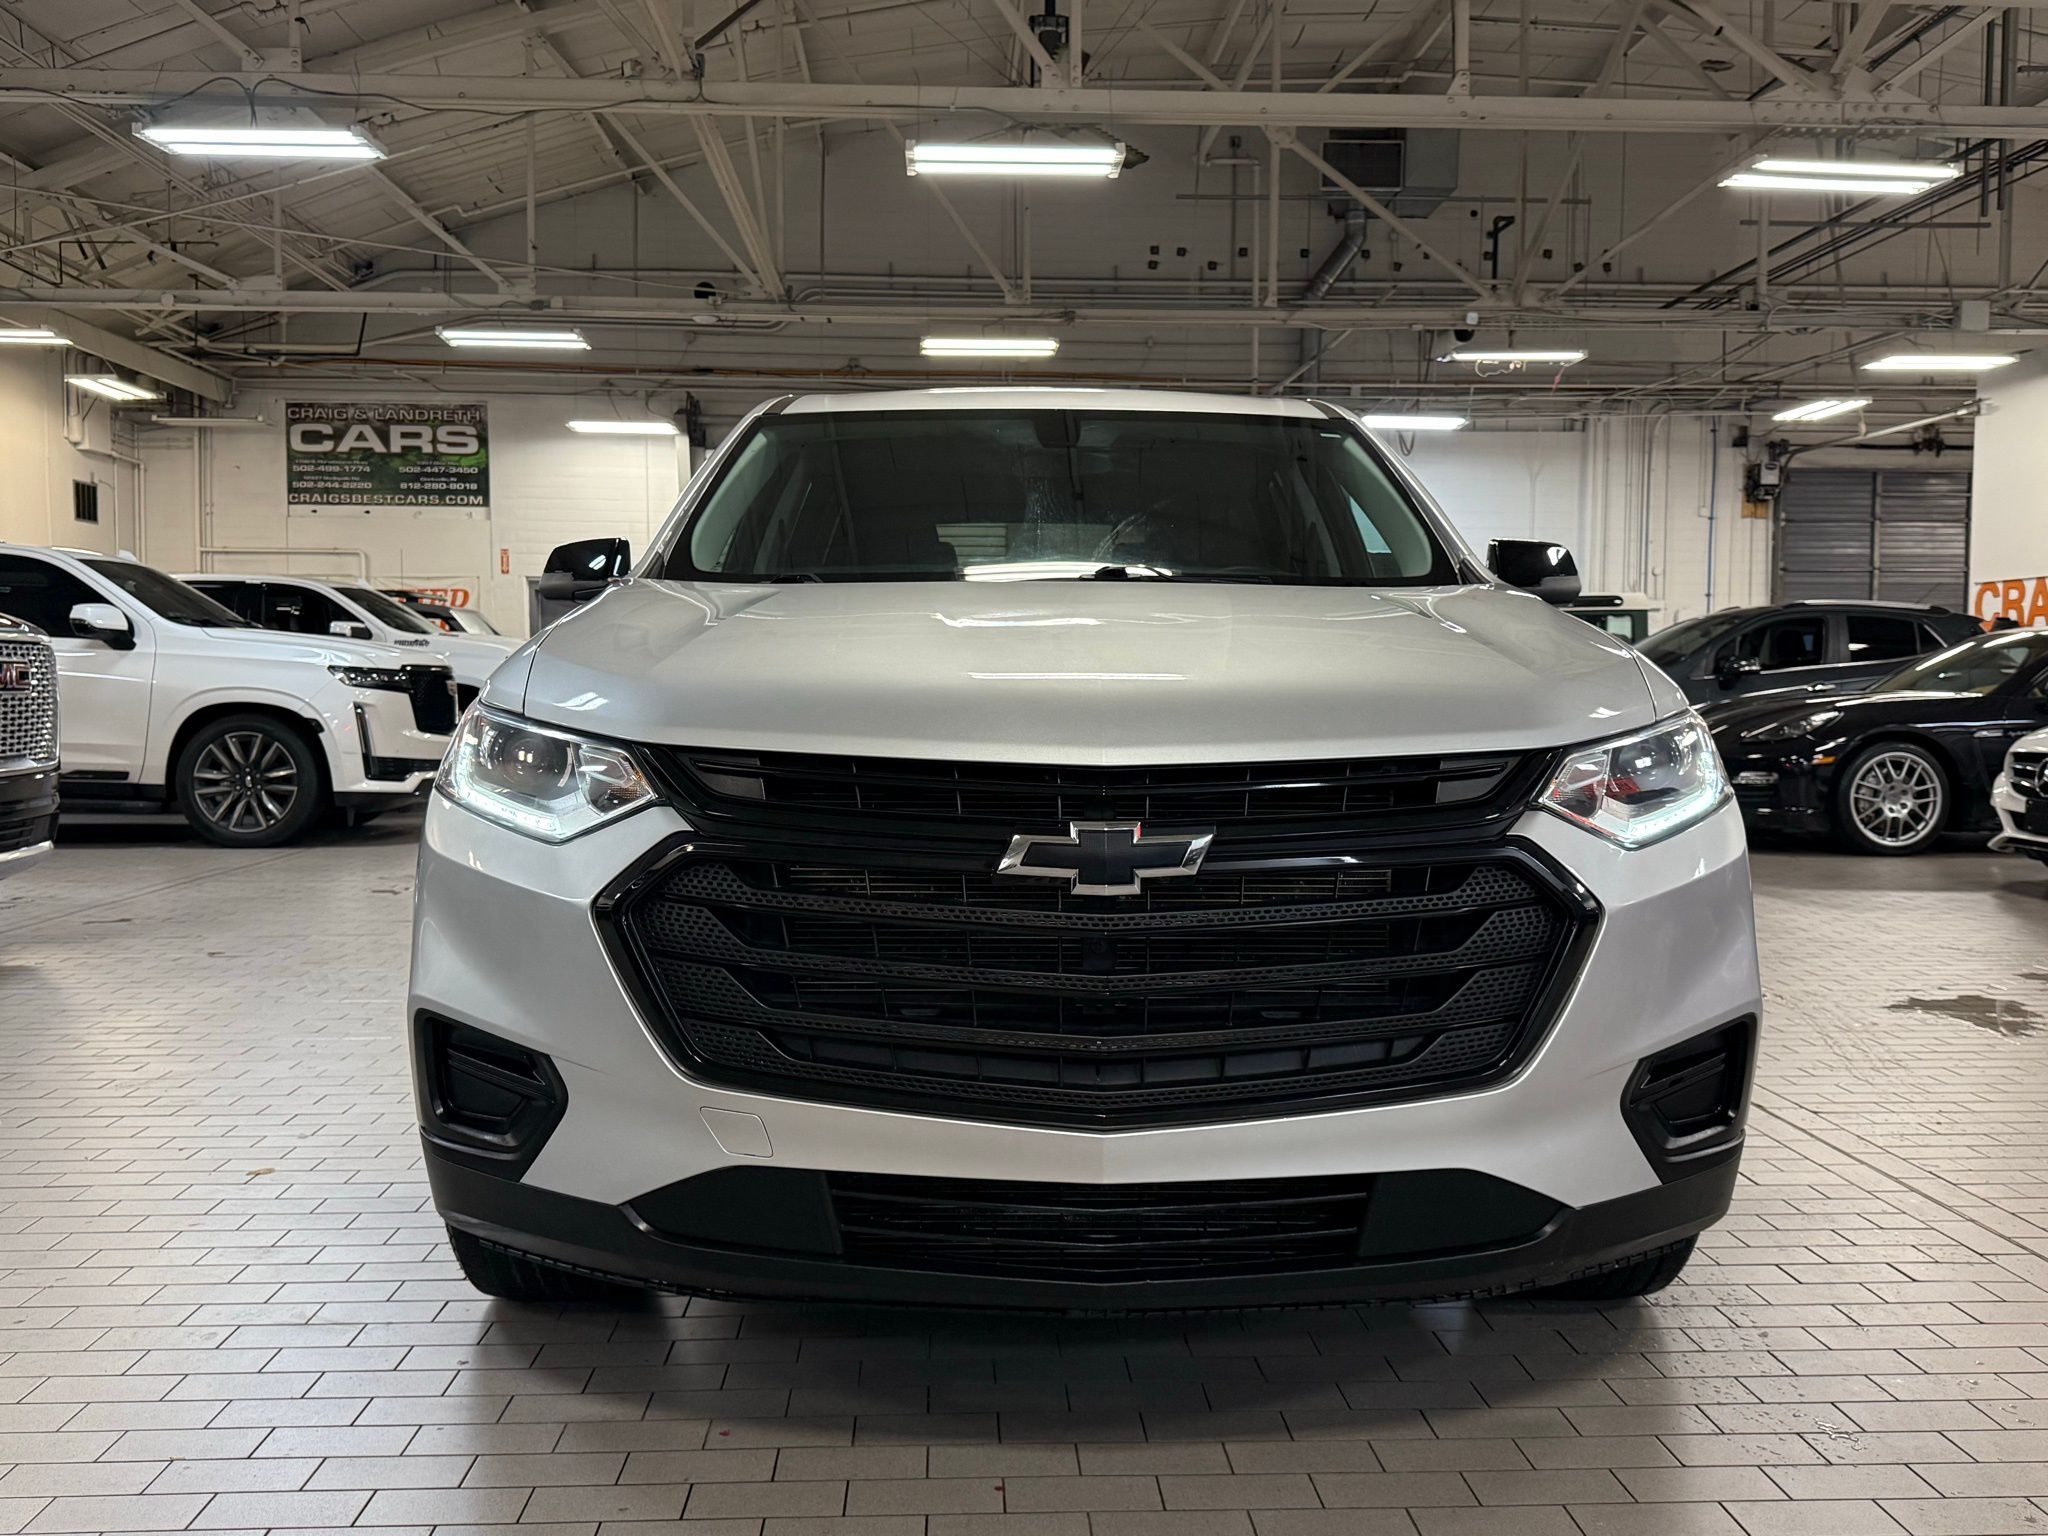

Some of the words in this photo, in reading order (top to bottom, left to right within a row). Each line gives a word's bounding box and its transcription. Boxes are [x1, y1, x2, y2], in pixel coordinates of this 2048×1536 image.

[287, 407, 347, 420] CRAIG
[354, 408, 368, 420] &
[375, 408, 480, 421] LANDRETH
[289, 423, 479, 454] CARS
[289, 493, 484, 505] CRAIGSBESTCARS.COM
